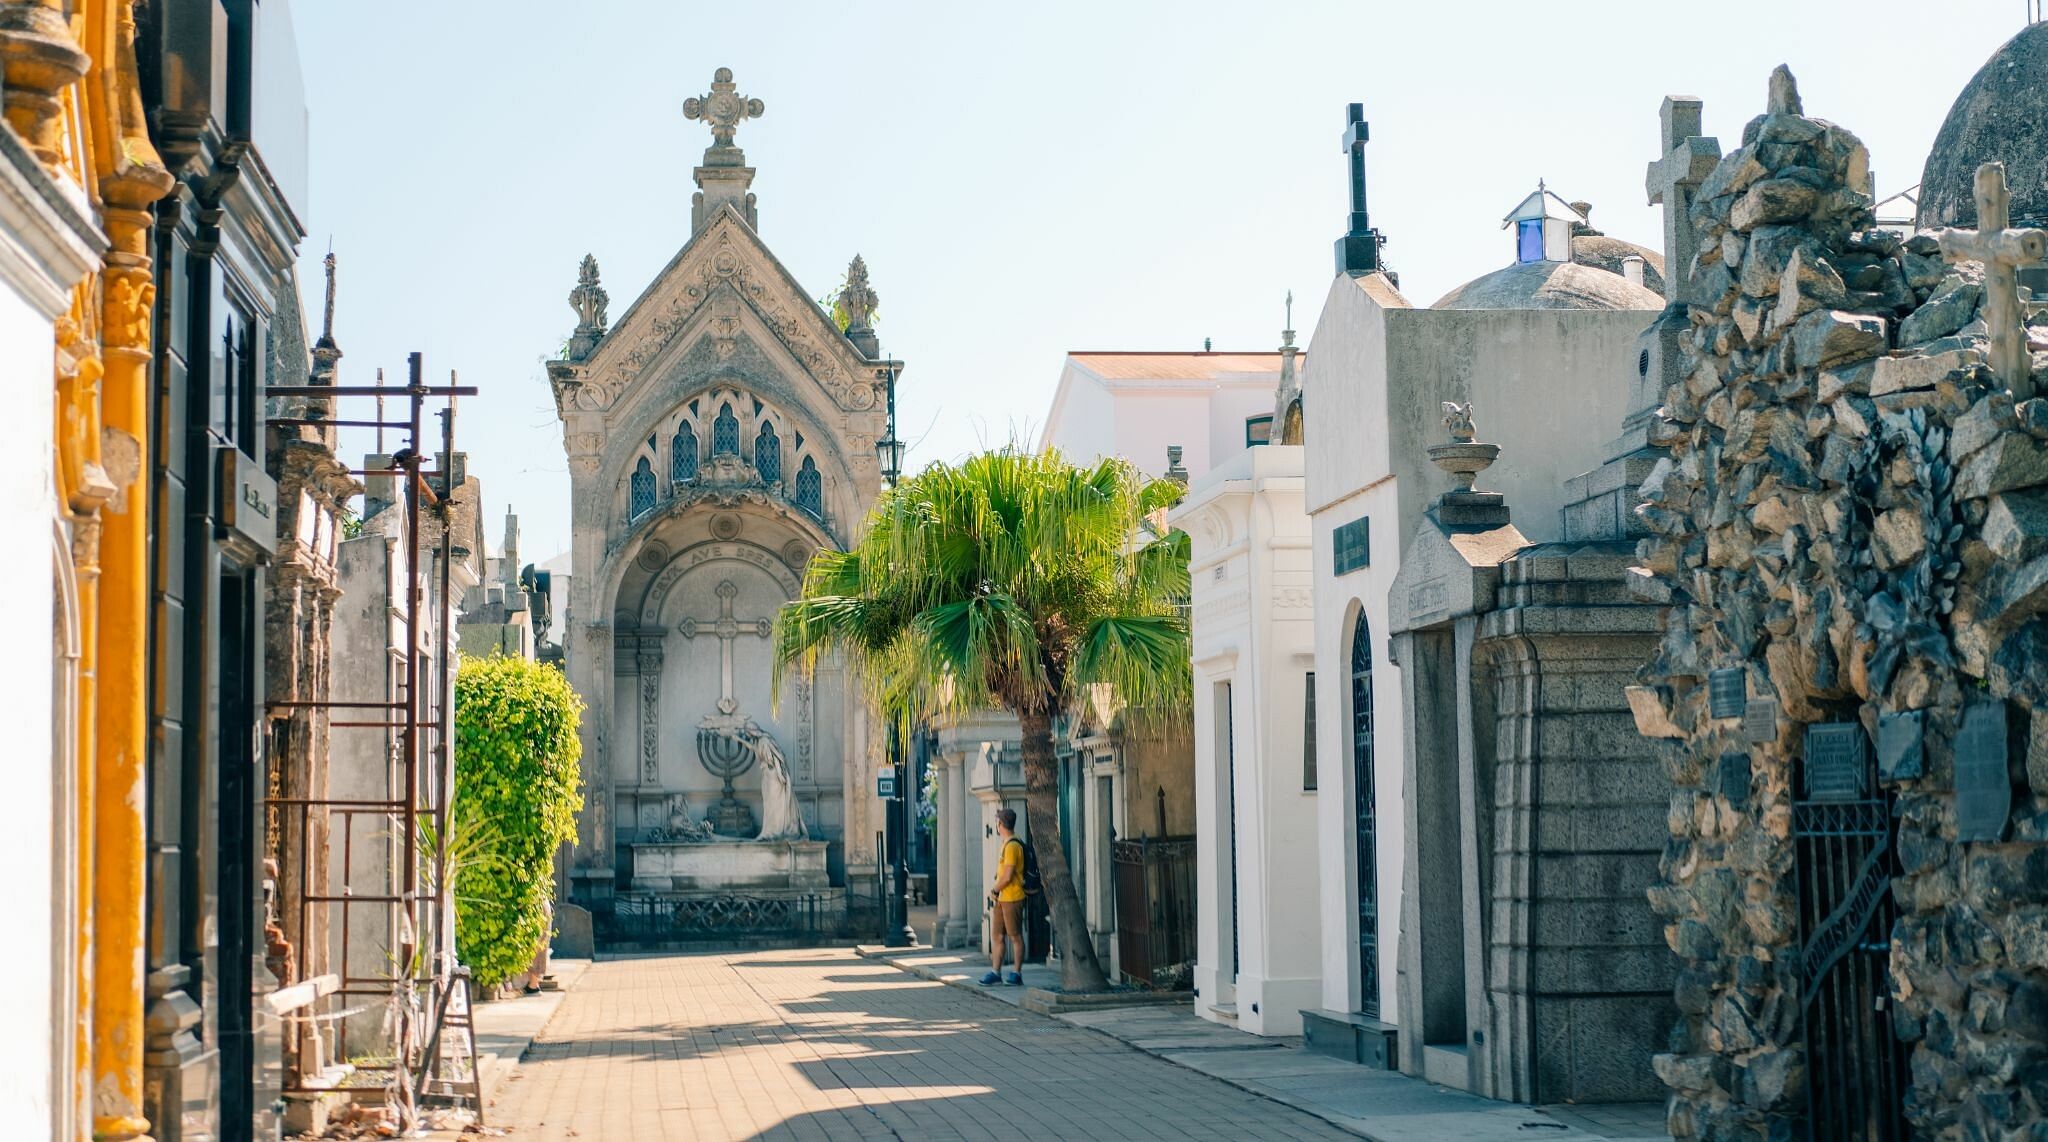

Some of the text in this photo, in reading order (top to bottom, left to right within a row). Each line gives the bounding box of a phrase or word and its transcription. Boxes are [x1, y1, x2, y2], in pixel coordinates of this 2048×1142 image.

[690, 546, 722, 565] AVE
[736, 547, 774, 569] SPES
[1848, 858, 1884, 931] GUIDO
